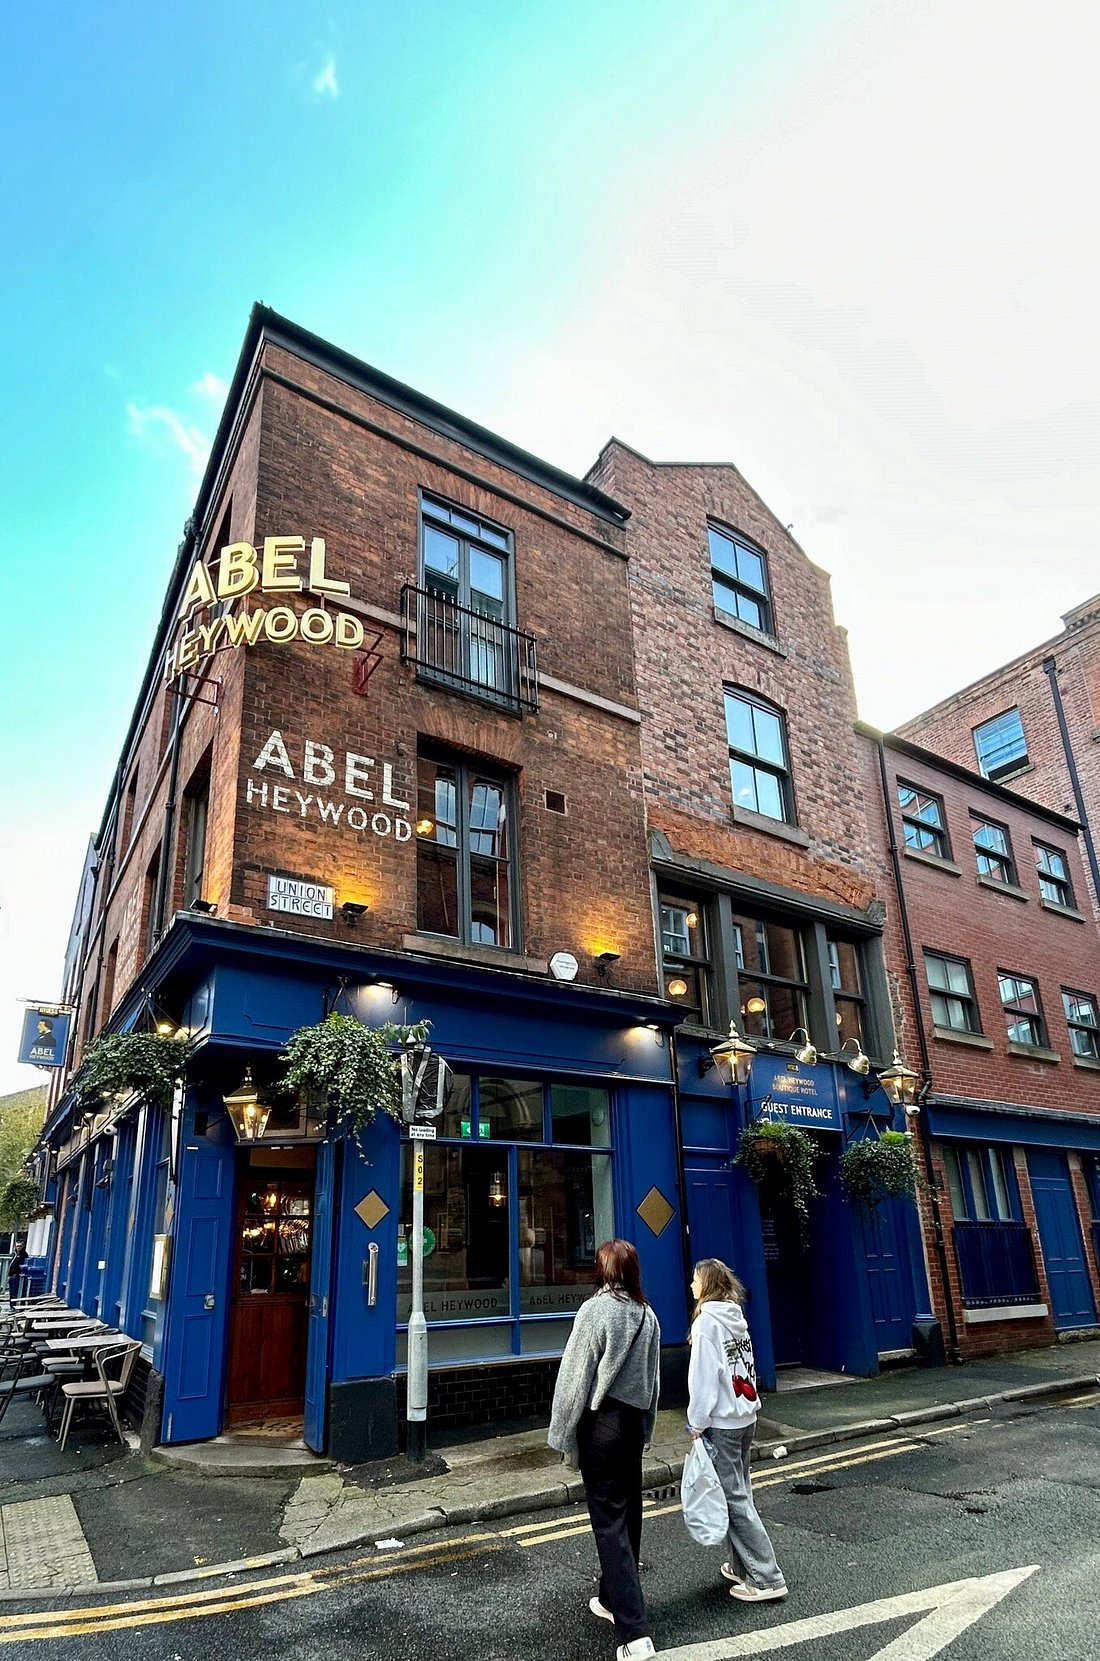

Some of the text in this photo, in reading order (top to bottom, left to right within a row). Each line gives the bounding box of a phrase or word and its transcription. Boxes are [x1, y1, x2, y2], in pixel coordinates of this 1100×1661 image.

[178, 535, 351, 625] ABEL
[164, 606, 364, 690] HEYWOOD
[252, 730, 410, 811] ABEL
[246, 778, 412, 842] HEYWOOD
[277, 881, 326, 901] UNION
[270, 894, 331, 916] STREET
[30, 1047, 55, 1057] ABEL
[800, 1087, 819, 1096] HOTEL
[761, 1101, 833, 1119] GUEST ENTRANCE
[441, 1298, 497, 1312] HEYWOOD
[529, 1294, 555, 1305] ABEL
